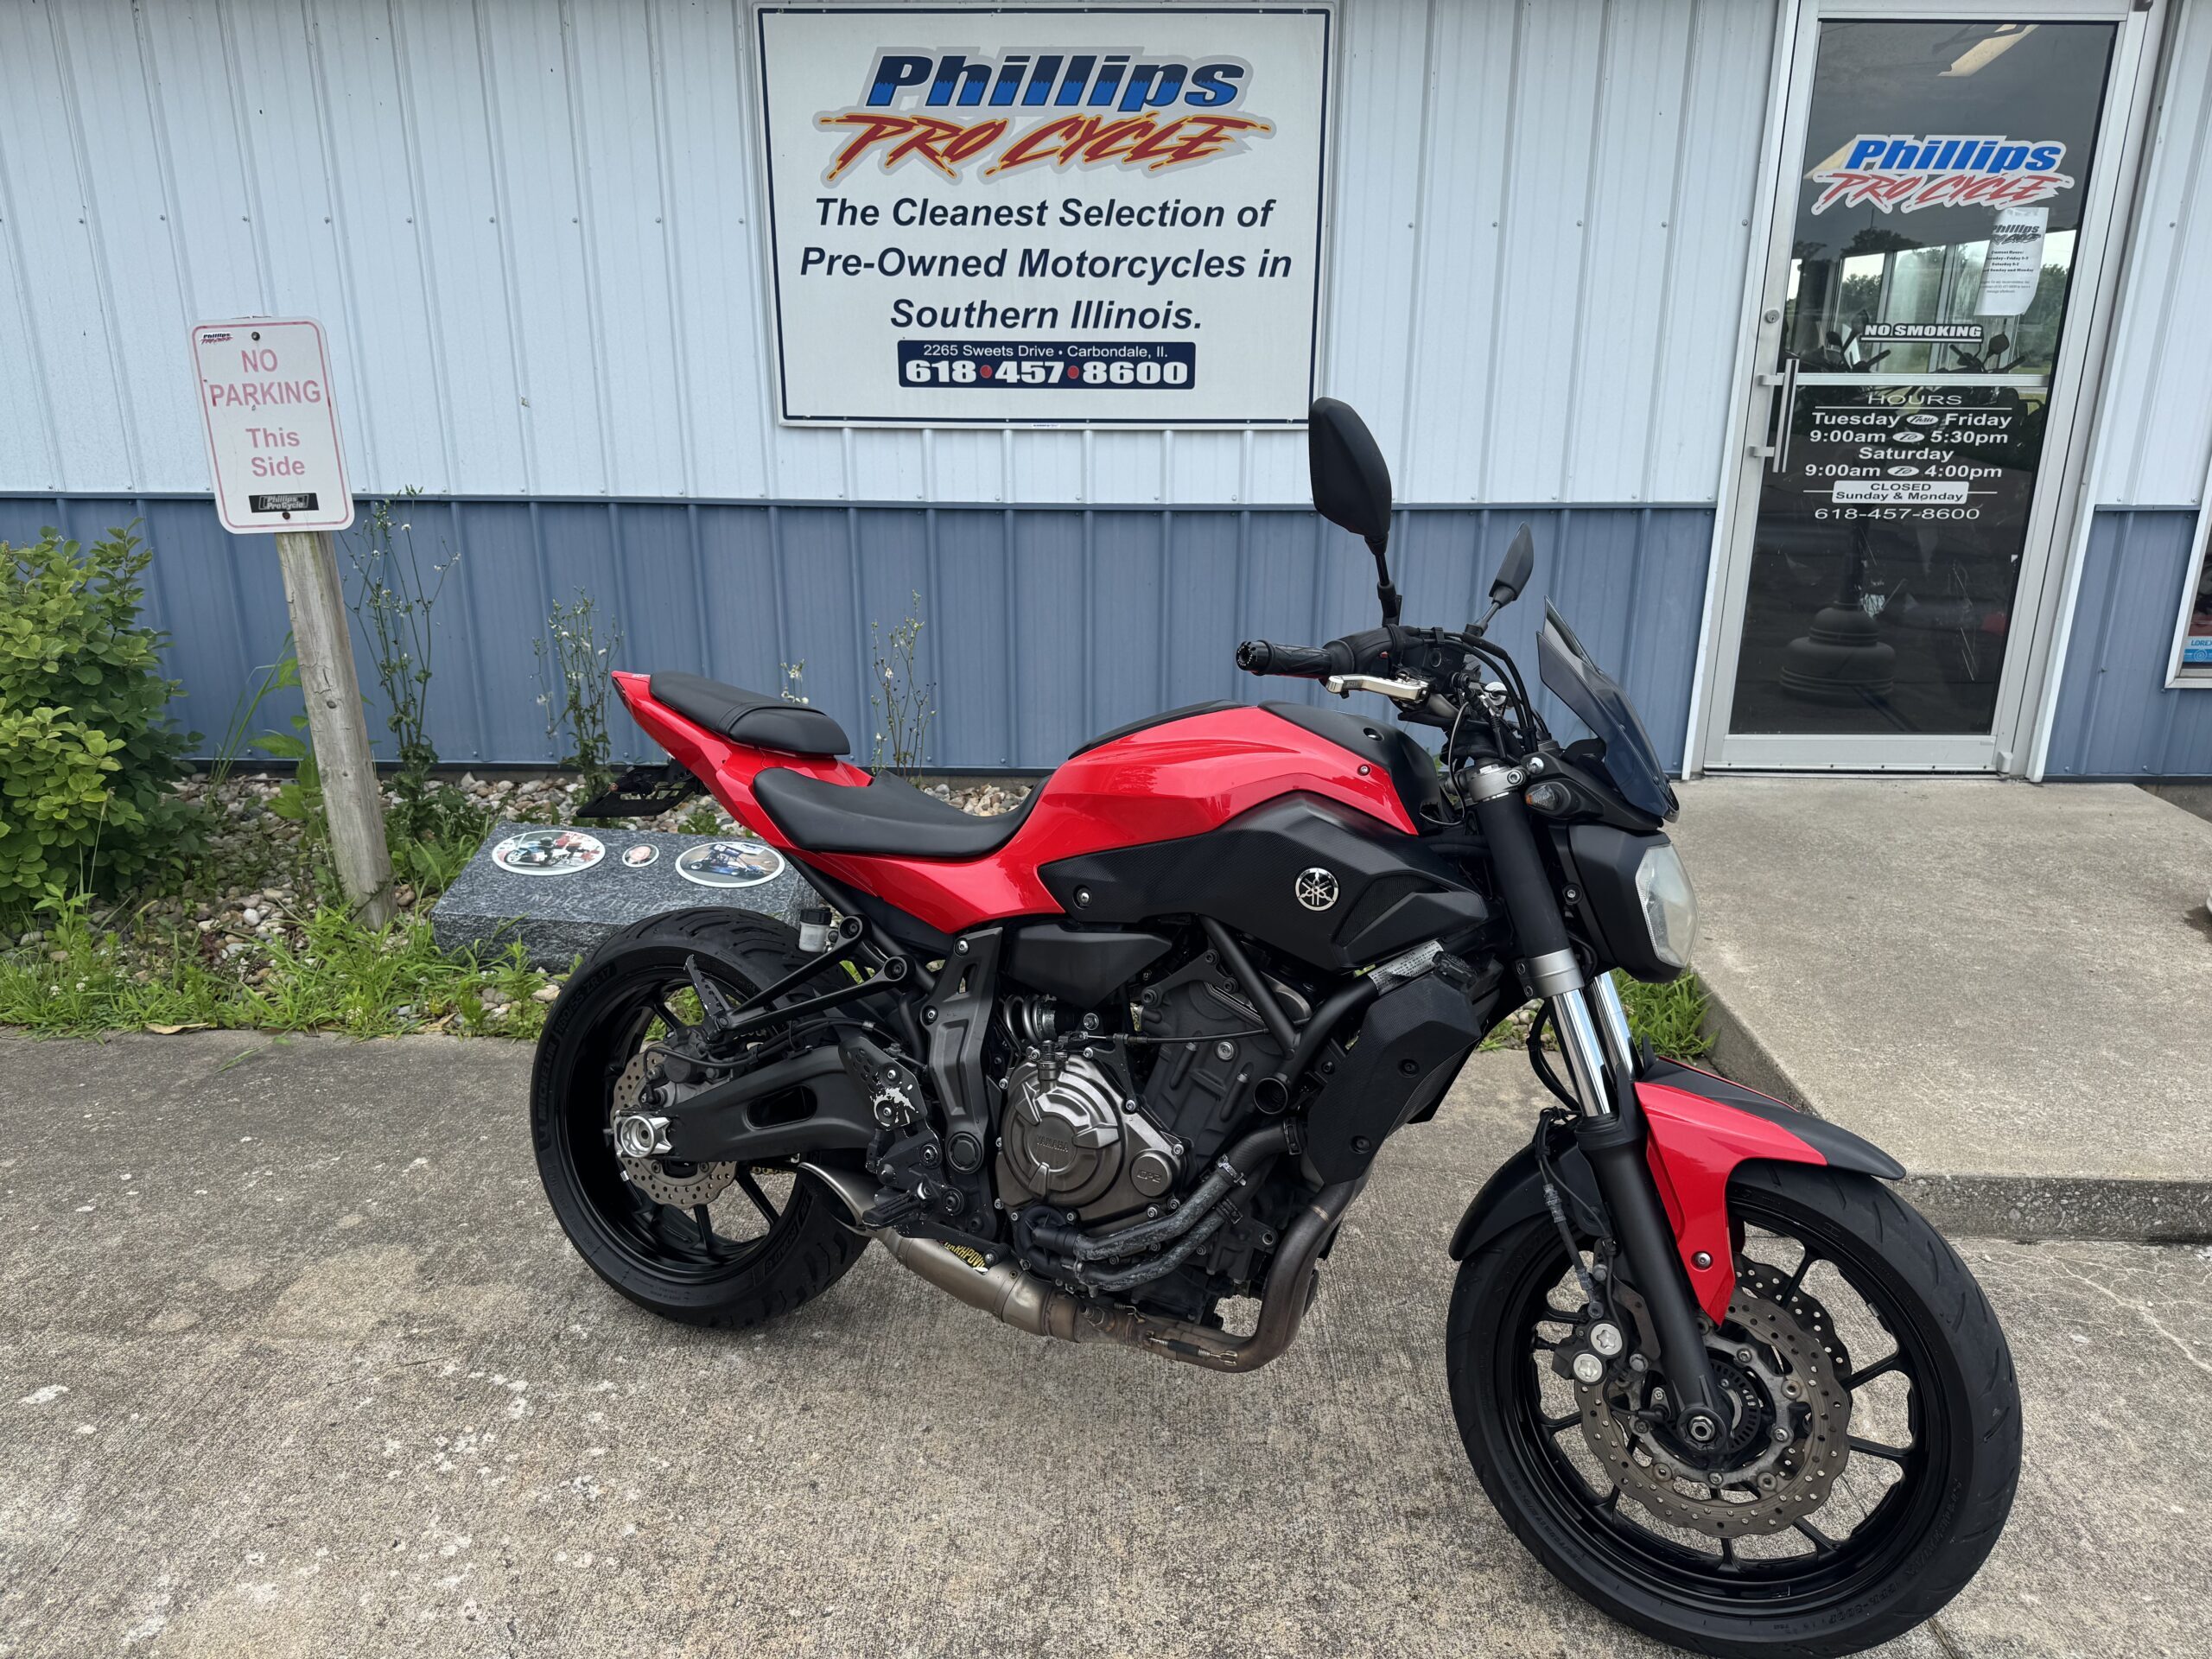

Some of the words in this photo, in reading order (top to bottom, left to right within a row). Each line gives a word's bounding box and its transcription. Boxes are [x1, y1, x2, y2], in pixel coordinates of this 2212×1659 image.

[865, 55, 1245, 112] Phillips
[819, 113, 1008, 180] PRO
[985, 111, 1270, 176] CYCLE
[1845, 140, 2062, 173] Phillips
[1815, 173, 1922, 211] PRO
[1905, 173, 2070, 207] CYCLE
[816, 198, 880, 226] The
[893, 198, 1049, 226] Cleanest
[1058, 198, 1225, 227] Selection
[1236, 199, 1276, 227] of
[801, 247, 1007, 277] Pre-Owned
[1018, 248, 1247, 286] Motorcycles
[1258, 248, 1293, 277] in
[891, 298, 1058, 329] Southern
[1071, 300, 1202, 329] Illinois.
[1865, 325, 1891, 336] NO
[1895, 325, 1982, 337] SMOKING
[241, 349, 277, 373] NO
[924, 345, 958, 356] 2265
[963, 345, 1014, 357] Sweets
[1018, 346, 1054, 357] Drive
[1067, 346, 1151, 359] Carbondale,
[209, 379, 321, 407] PARKING
[1868, 395, 1962, 404] HOURS
[1812, 412, 1901, 428] Tuesday
[1945, 413, 2012, 429] Friday
[245, 427, 300, 448] This
[1809, 430, 1886, 442] 9:00am
[1930, 430, 2008, 446] 5:30pm
[1859, 447, 1954, 462] Saturday
[251, 455, 305, 477] Side
[1805, 464, 1881, 476] 9:00am
[1924, 465, 2003, 480] 4:00pm
[1836, 492, 1888, 501] Sunday
[1908, 493, 1963, 502] Monday
[1815, 508, 1980, 519] 618-457-8600
[1037, 1135, 1069, 1153] YAMAHA
